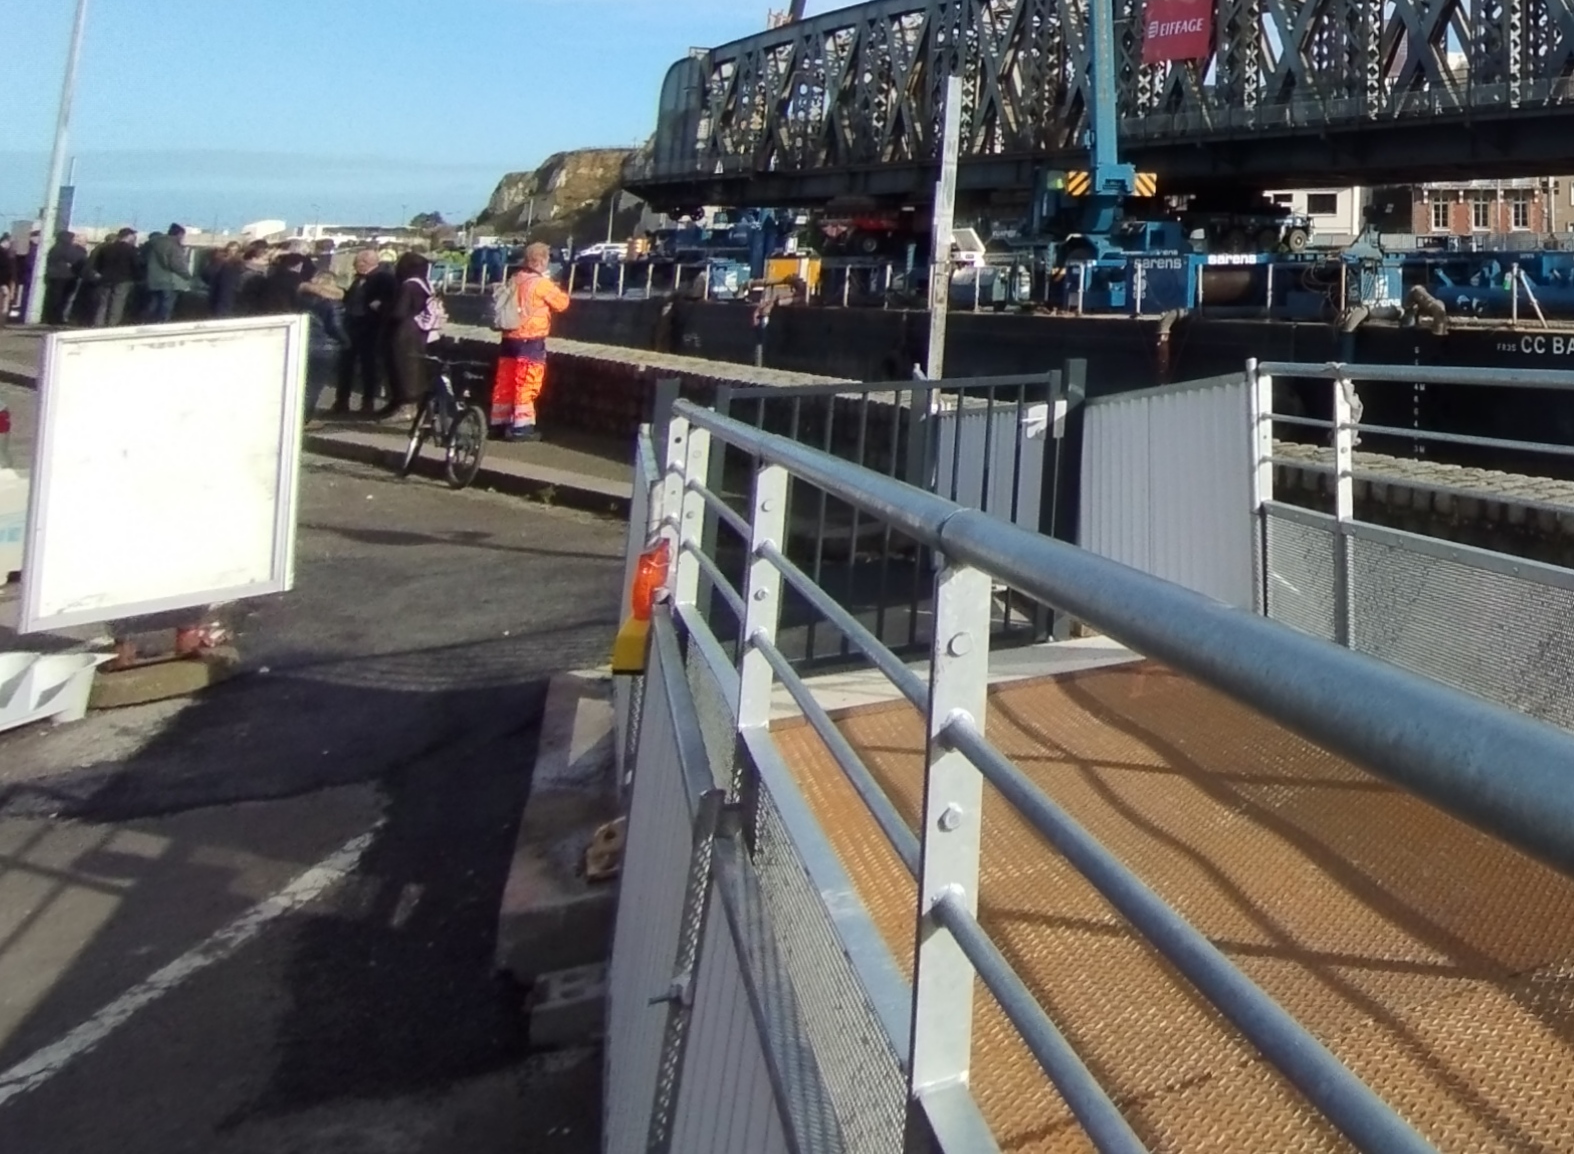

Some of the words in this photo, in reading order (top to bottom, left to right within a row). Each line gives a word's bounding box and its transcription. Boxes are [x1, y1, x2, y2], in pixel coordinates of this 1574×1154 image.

[1159, 18, 1204, 36] EIFFAGE
[1133, 257, 1182, 270] sarens
[1208, 254, 1257, 265] sarens
[1521, 335, 1546, 354] CC
